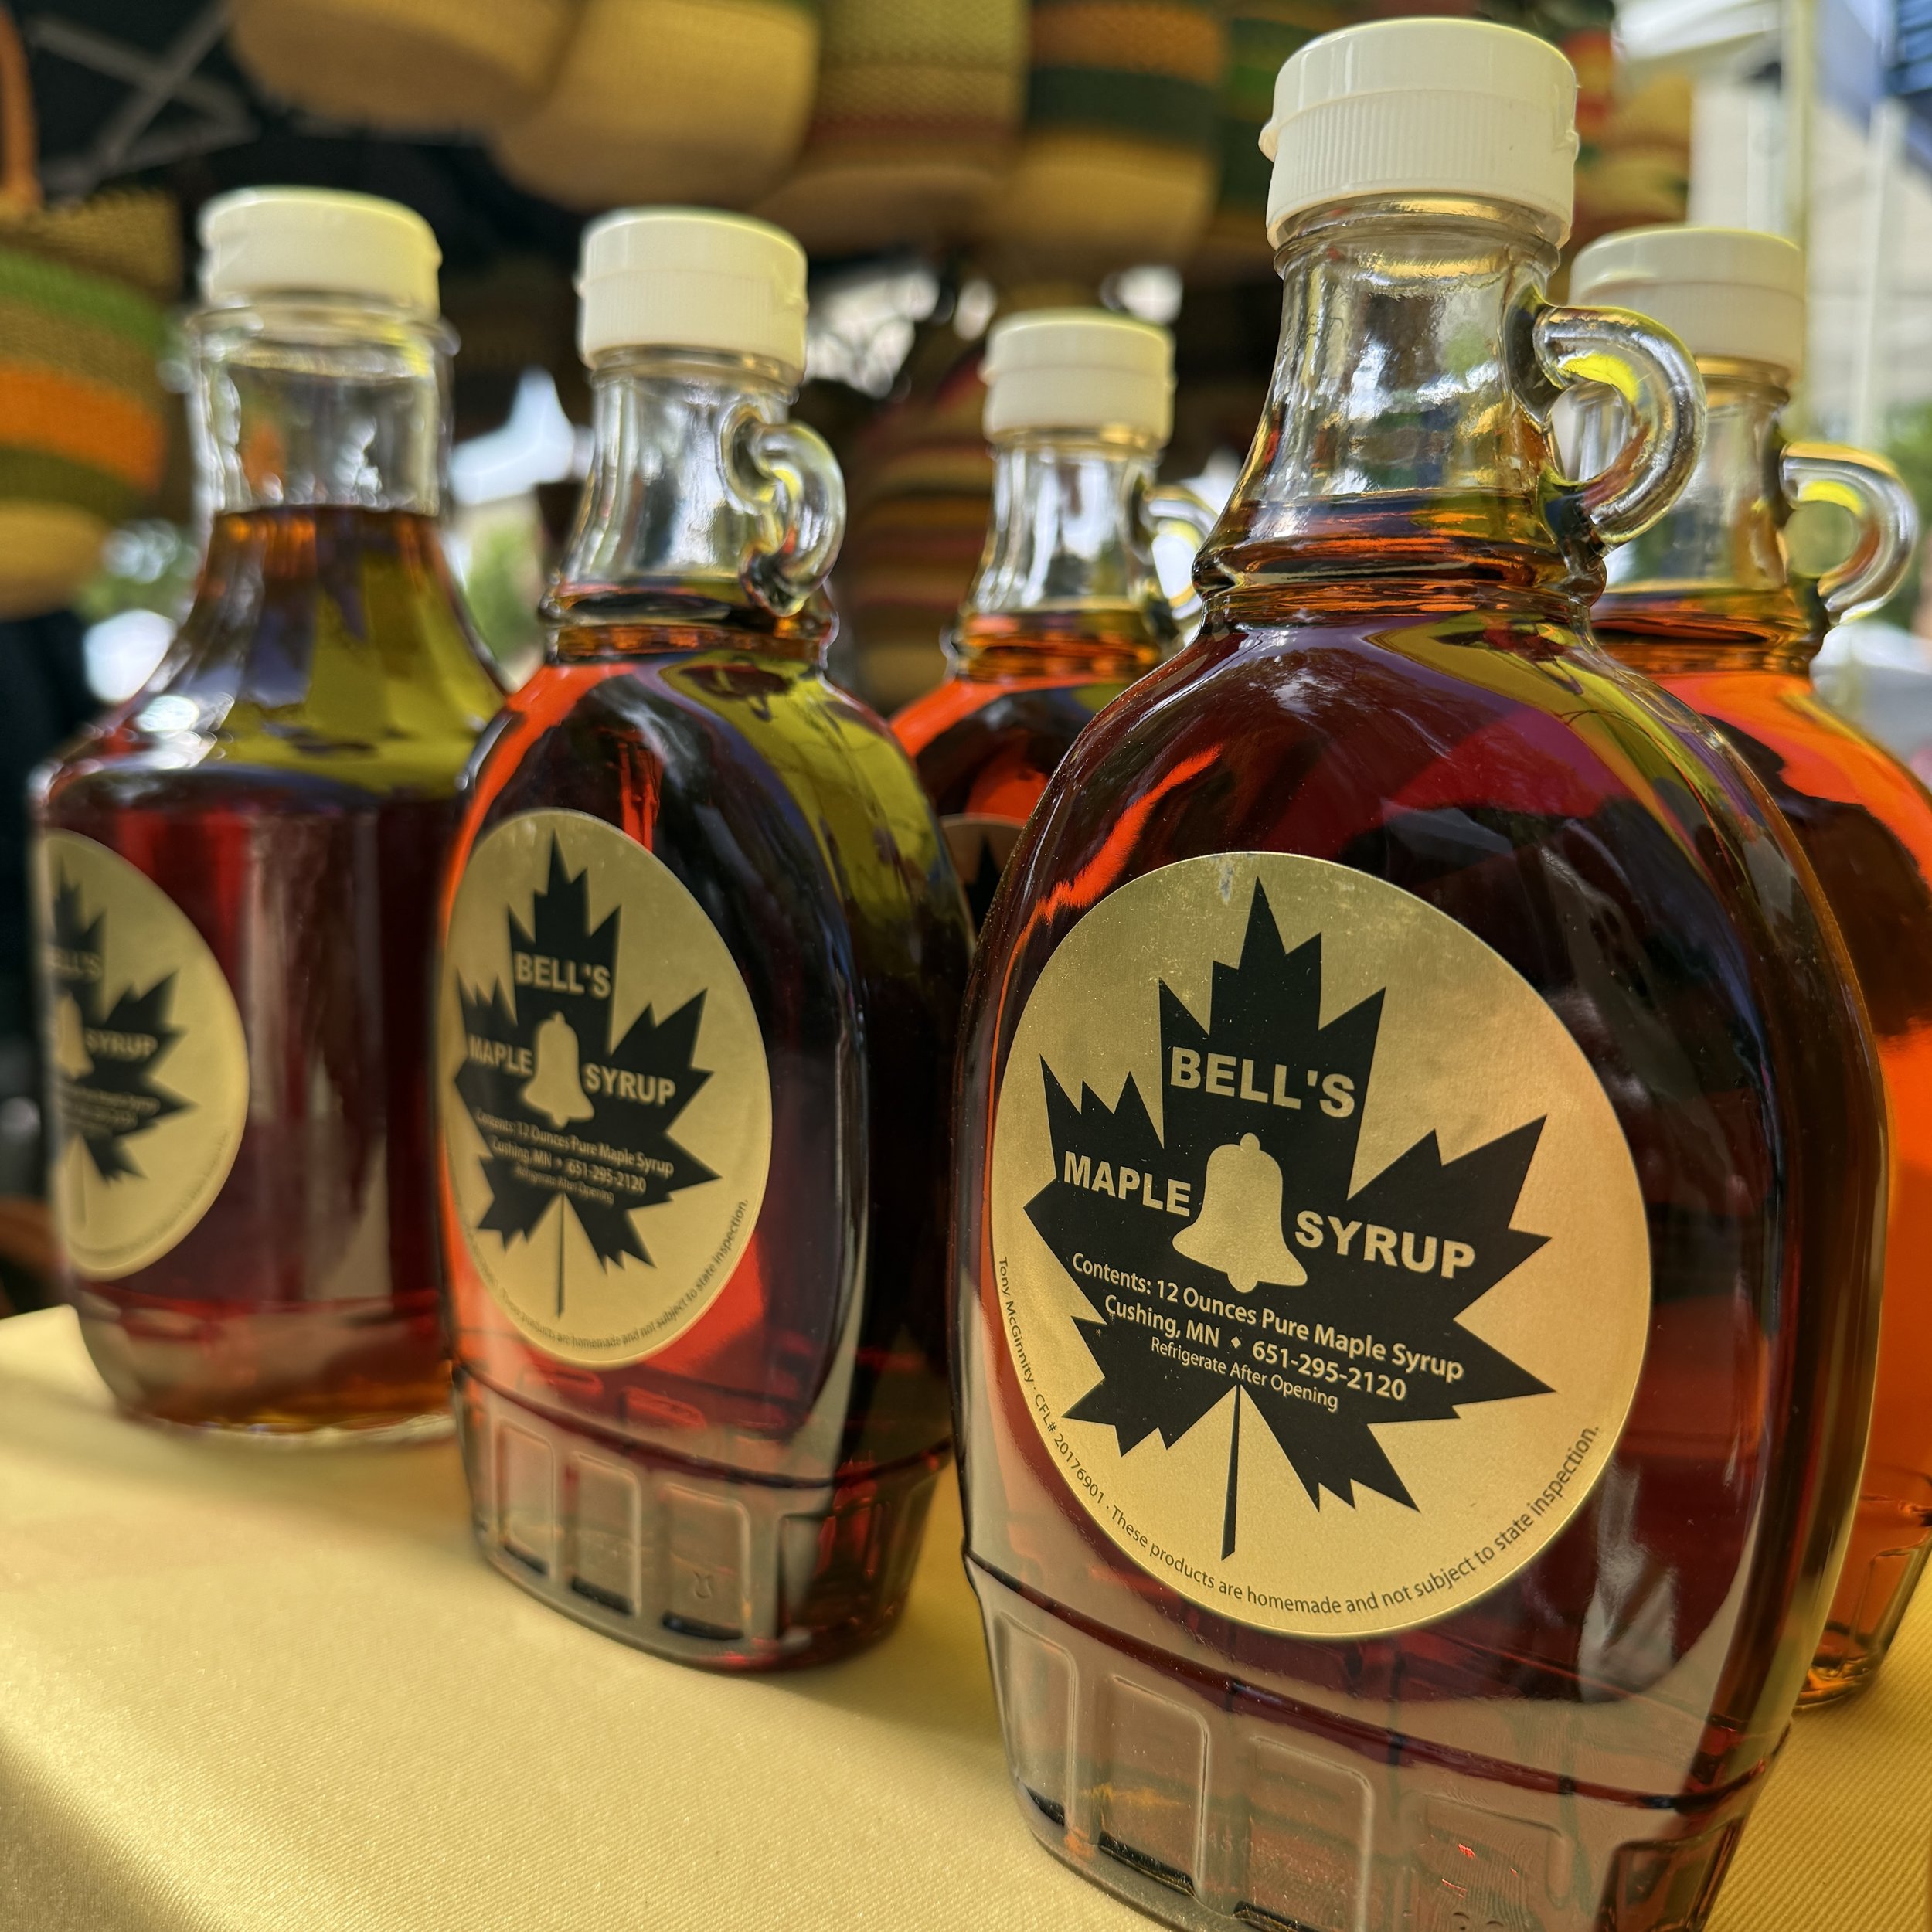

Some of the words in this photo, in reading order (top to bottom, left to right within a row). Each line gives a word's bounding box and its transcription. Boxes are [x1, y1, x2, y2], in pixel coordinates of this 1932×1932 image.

[513, 951, 611, 999] BELL'S
[468, 1032, 533, 1077] MAPLE
[583, 1063, 675, 1106] SYRUP
[1170, 1046, 1355, 1118] BELL'S
[530, 1124, 570, 1151] Ounces
[570, 1134, 597, 1156] Pure
[598, 1141, 635, 1166] Maple
[635, 1151, 674, 1179] Syrup
[565, 1160, 646, 1196] 651-295-2120
[1063, 1150, 1191, 1217] MAPLE
[1294, 1209, 1476, 1280] SYRUP
[623, 1329, 640, 1345] and
[641, 1321, 656, 1338] not
[657, 1298, 687, 1329] subject
[686, 1287, 698, 1303] to
[696, 1264, 716, 1291] state
[712, 1199, 748, 1265] inspection.
[1072, 1252, 1151, 1295] Contents:
[1157, 1279, 1179, 1303] 12
[1182, 1287, 1257, 1325] Ounces
[1261, 1307, 1310, 1342] Pure
[1314, 1322, 1387, 1361] Maple
[1392, 1342, 1465, 1384] Syrup
[1104, 1294, 1182, 1339] Cushing,
[1185, 1318, 1220, 1348] MN
[1252, 1340, 1407, 1402] 651-295-2120
[1151, 1335, 1227, 1375] Refrigerate
[1229, 1362, 1268, 1387] After
[1270, 1373, 1339, 1413] Opening
[998, 1256, 1011, 1298] Tony
[1005, 1300, 1036, 1383] McGinnity
[1034, 1393, 1057, 1433] CFL#
[1053, 1432, 1105, 1504] 20176901
[1111, 1504, 1148, 1548] These
[1149, 1542, 1215, 1589] products
[1218, 1580, 1243, 1600] are
[1247, 1585, 1342, 1614] homemade
[1346, 1591, 1379, 1614] and
[1381, 1586, 1413, 1607] not
[1413, 1556, 1477, 1597] subject
[1475, 1545, 1495, 1566] to
[1493, 1515, 1534, 1552] state
[1526, 1425, 1600, 1517] inspection.
